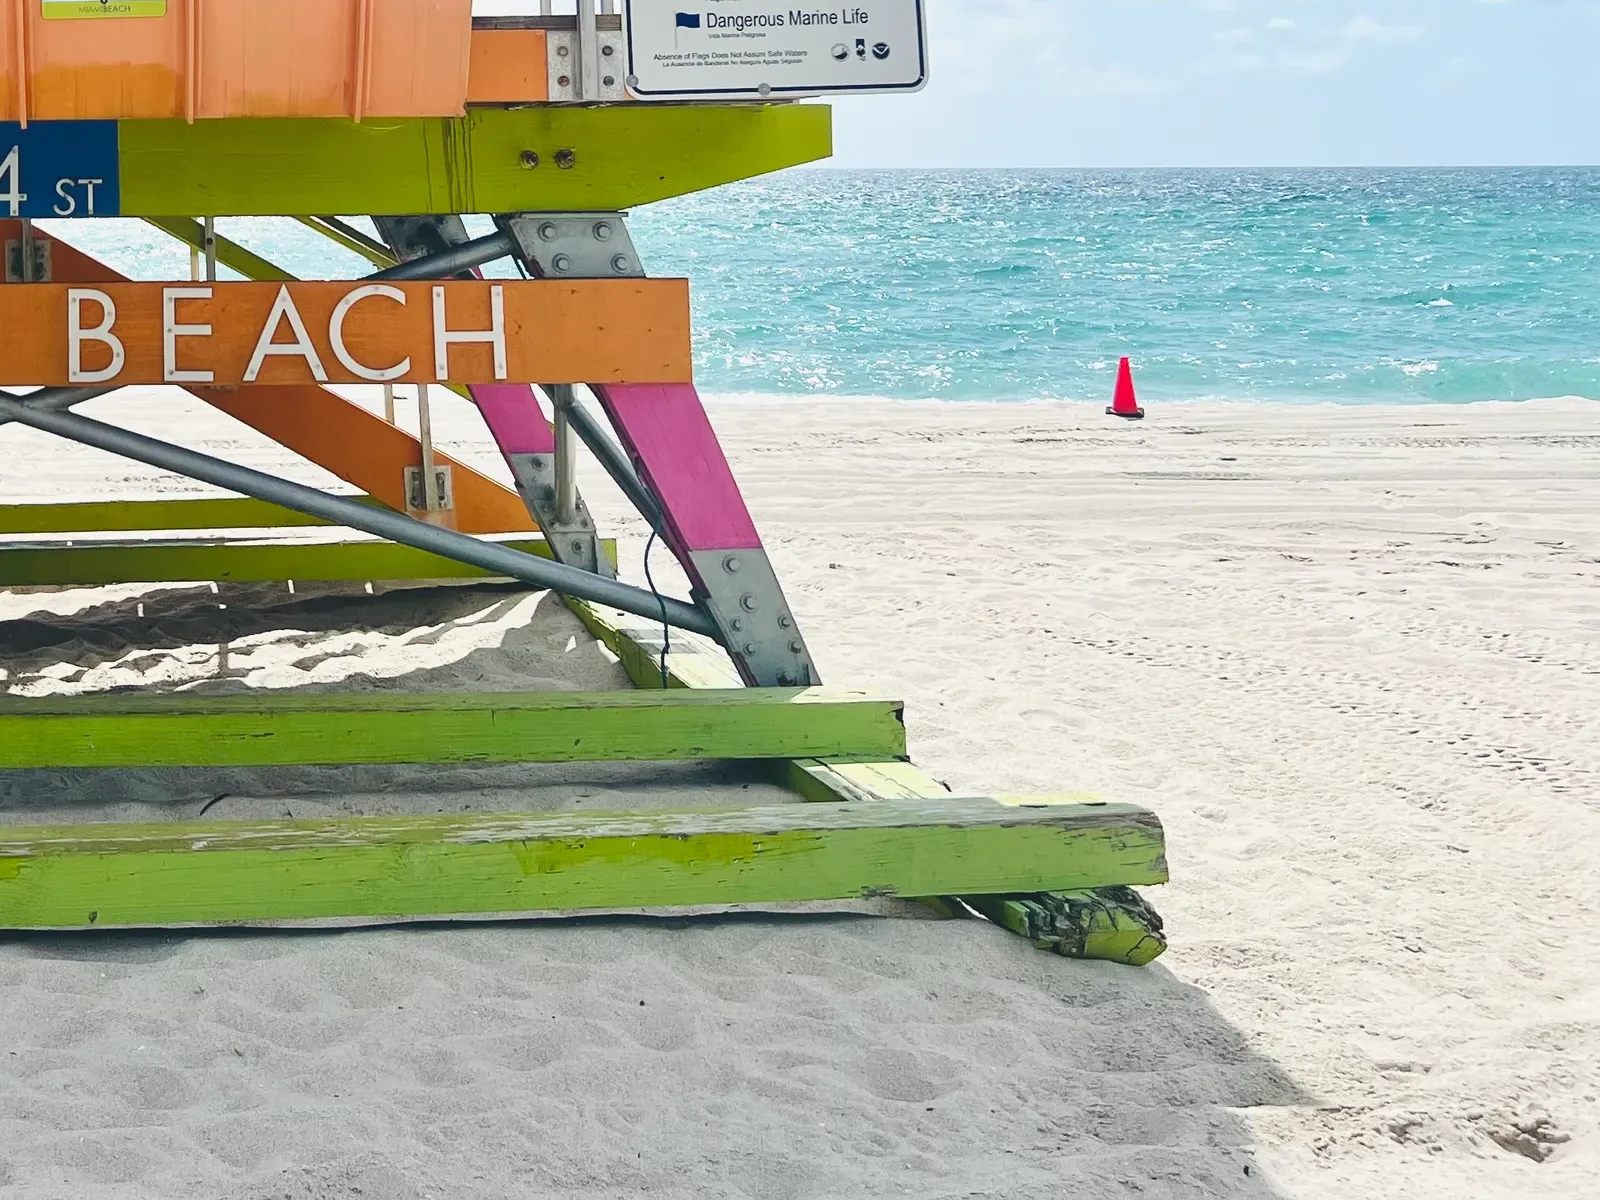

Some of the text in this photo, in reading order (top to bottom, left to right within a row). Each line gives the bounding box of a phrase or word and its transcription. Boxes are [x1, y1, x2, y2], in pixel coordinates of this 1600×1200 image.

[706, 8, 869, 31] Dangerous Marine Life
[53, 178, 103, 216] ST
[68, 283, 507, 383] BEACH
